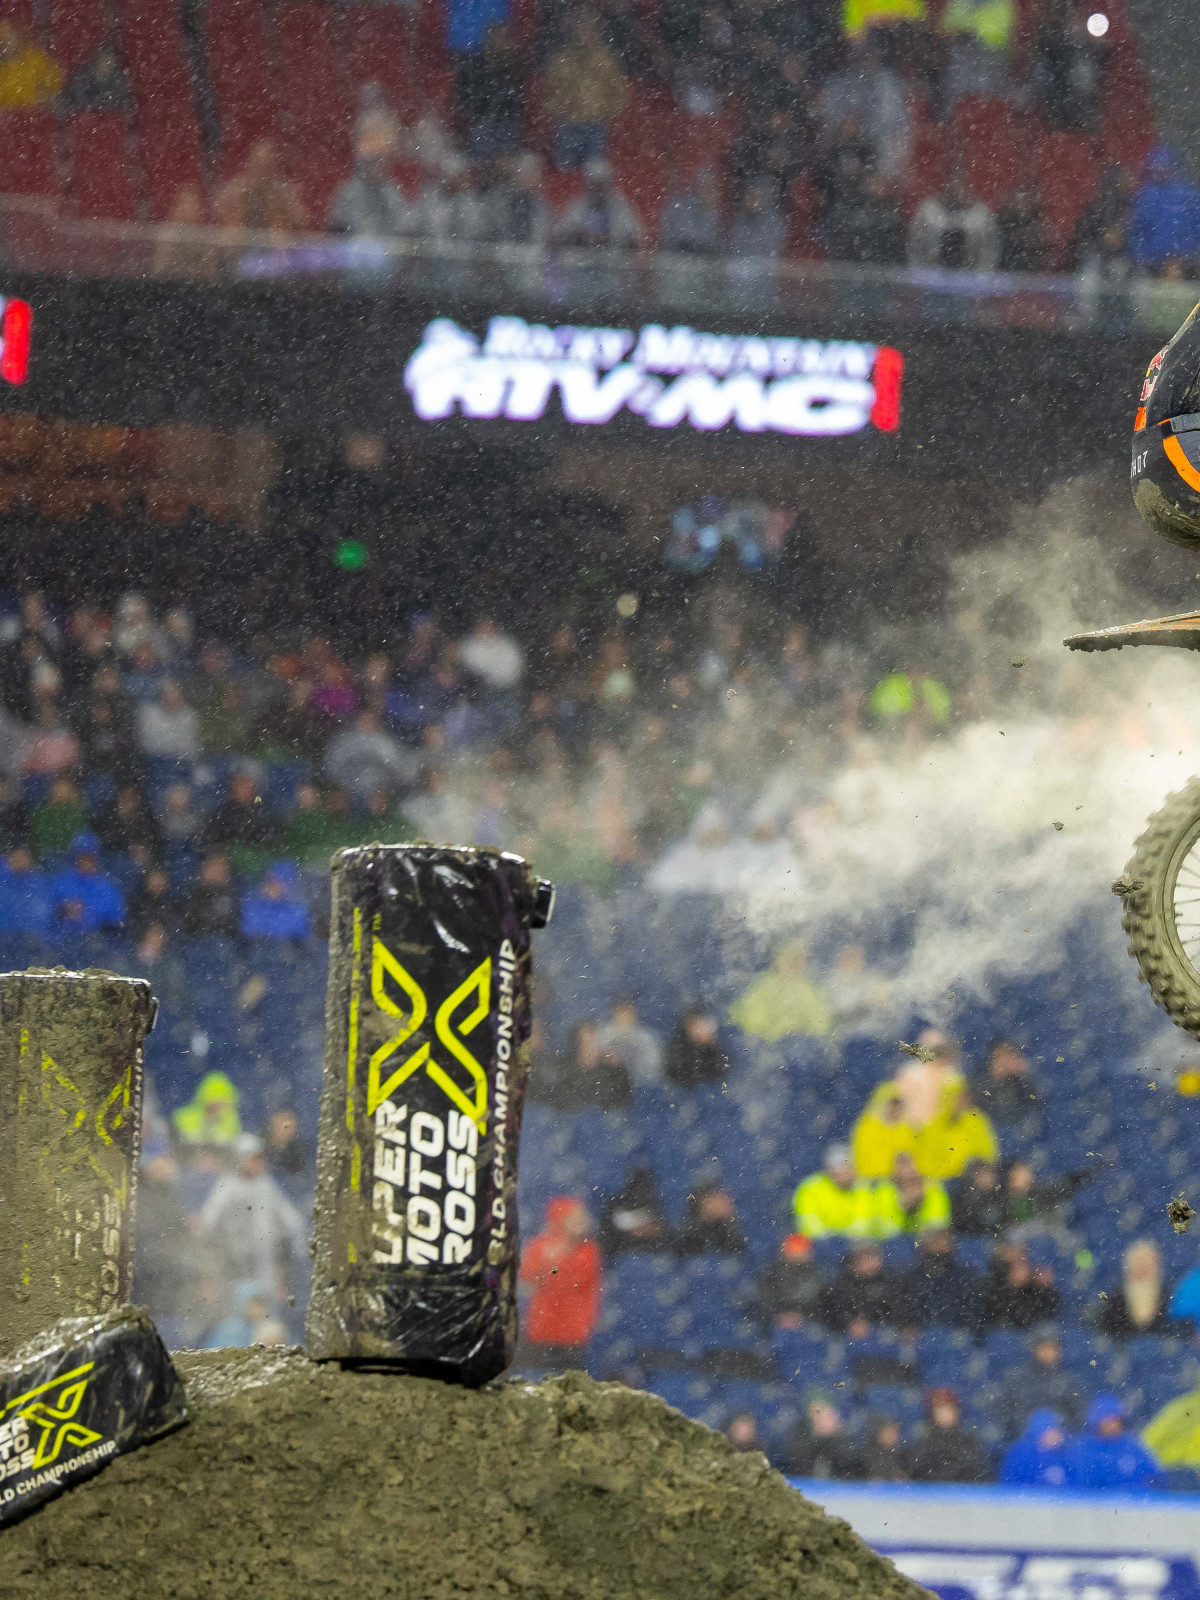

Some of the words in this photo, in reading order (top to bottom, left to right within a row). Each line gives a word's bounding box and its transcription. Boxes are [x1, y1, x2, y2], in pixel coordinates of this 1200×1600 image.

[492, 938, 517, 1189] CHAMPIONSHIP
[372, 1099, 408, 1264] UPER
[442, 1109, 479, 1265] ROSS
[16, 1440, 117, 1495] CHAMPIONSHIP
